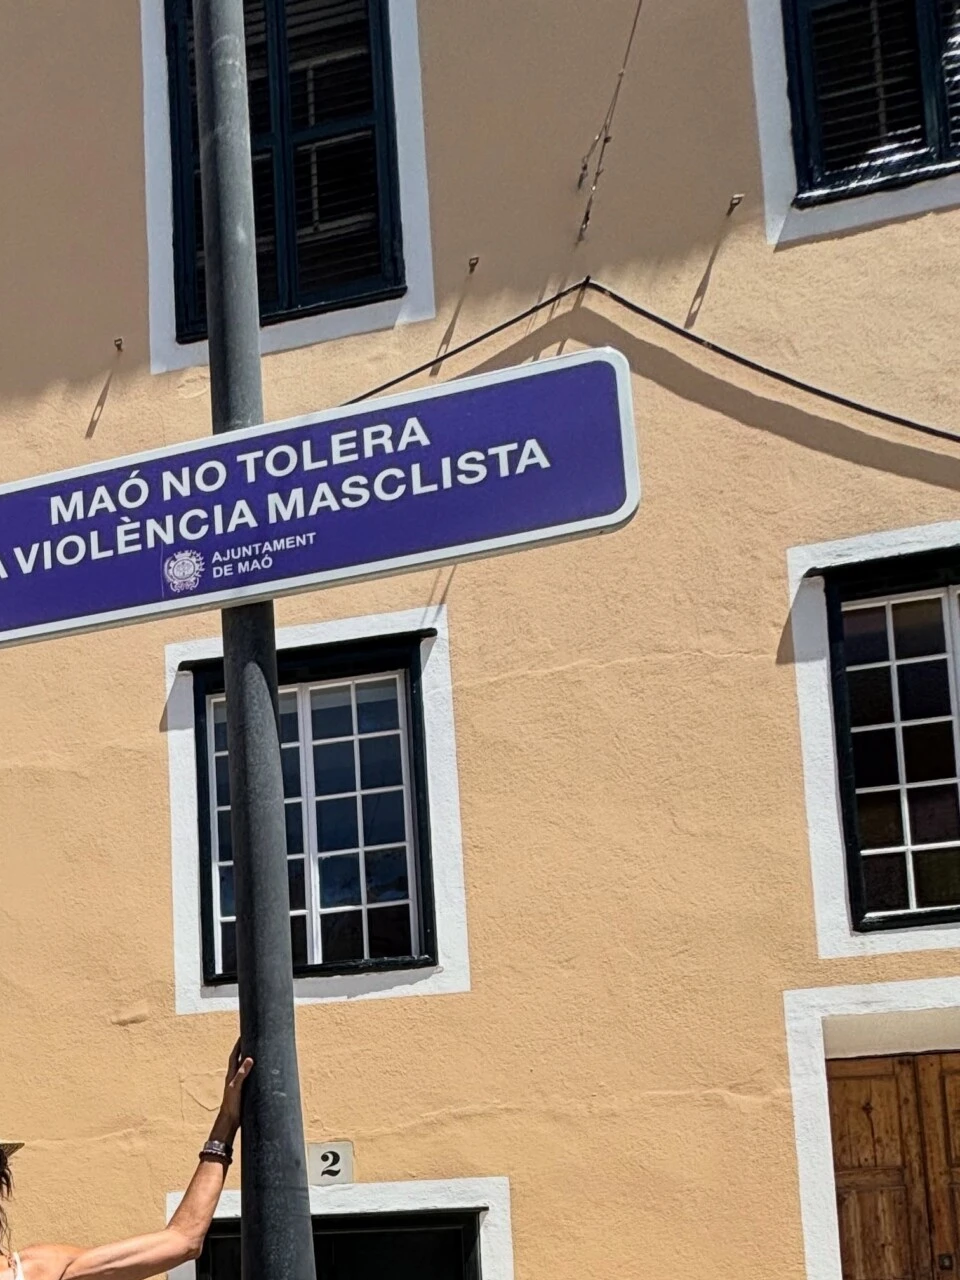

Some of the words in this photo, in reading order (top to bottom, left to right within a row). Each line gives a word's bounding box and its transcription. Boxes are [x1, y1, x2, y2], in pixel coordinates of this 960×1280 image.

[51, 469, 149, 526] MAÓ
[163, 460, 227, 502] NO
[236, 416, 431, 483] TOLERA
[13, 499, 258, 575] VIOLÈNCIA
[267, 438, 551, 524] MASCLISTA
[211, 532, 317, 564] AJUNTAMENT
[212, 563, 234, 579] DE
[237, 554, 273, 575] MAÓ
[320, 1150, 341, 1177] 2
